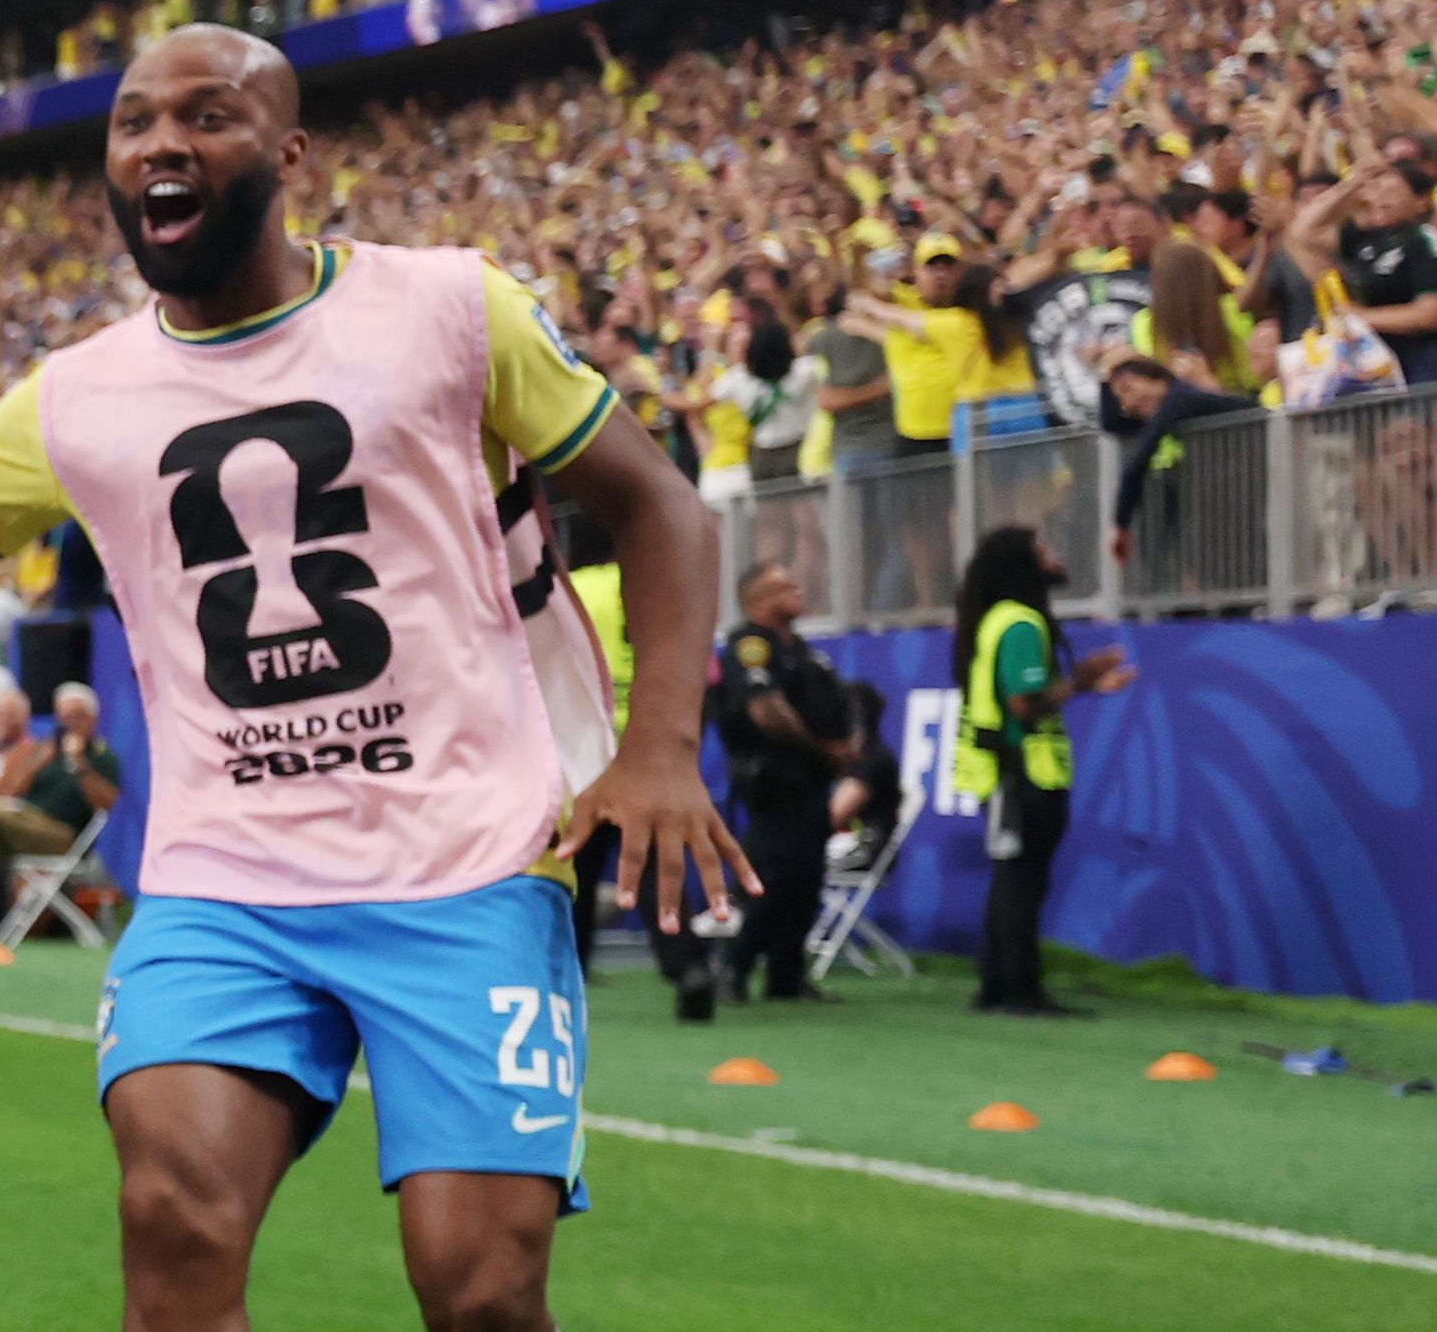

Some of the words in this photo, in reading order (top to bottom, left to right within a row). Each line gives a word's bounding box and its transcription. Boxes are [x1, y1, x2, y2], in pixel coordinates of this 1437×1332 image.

[245, 637, 341, 684] FIFA
[216, 715, 328, 750] WORLD
[336, 702, 405, 733] CUP
[224, 736, 415, 786] 2026
[489, 985, 576, 1099] 25
